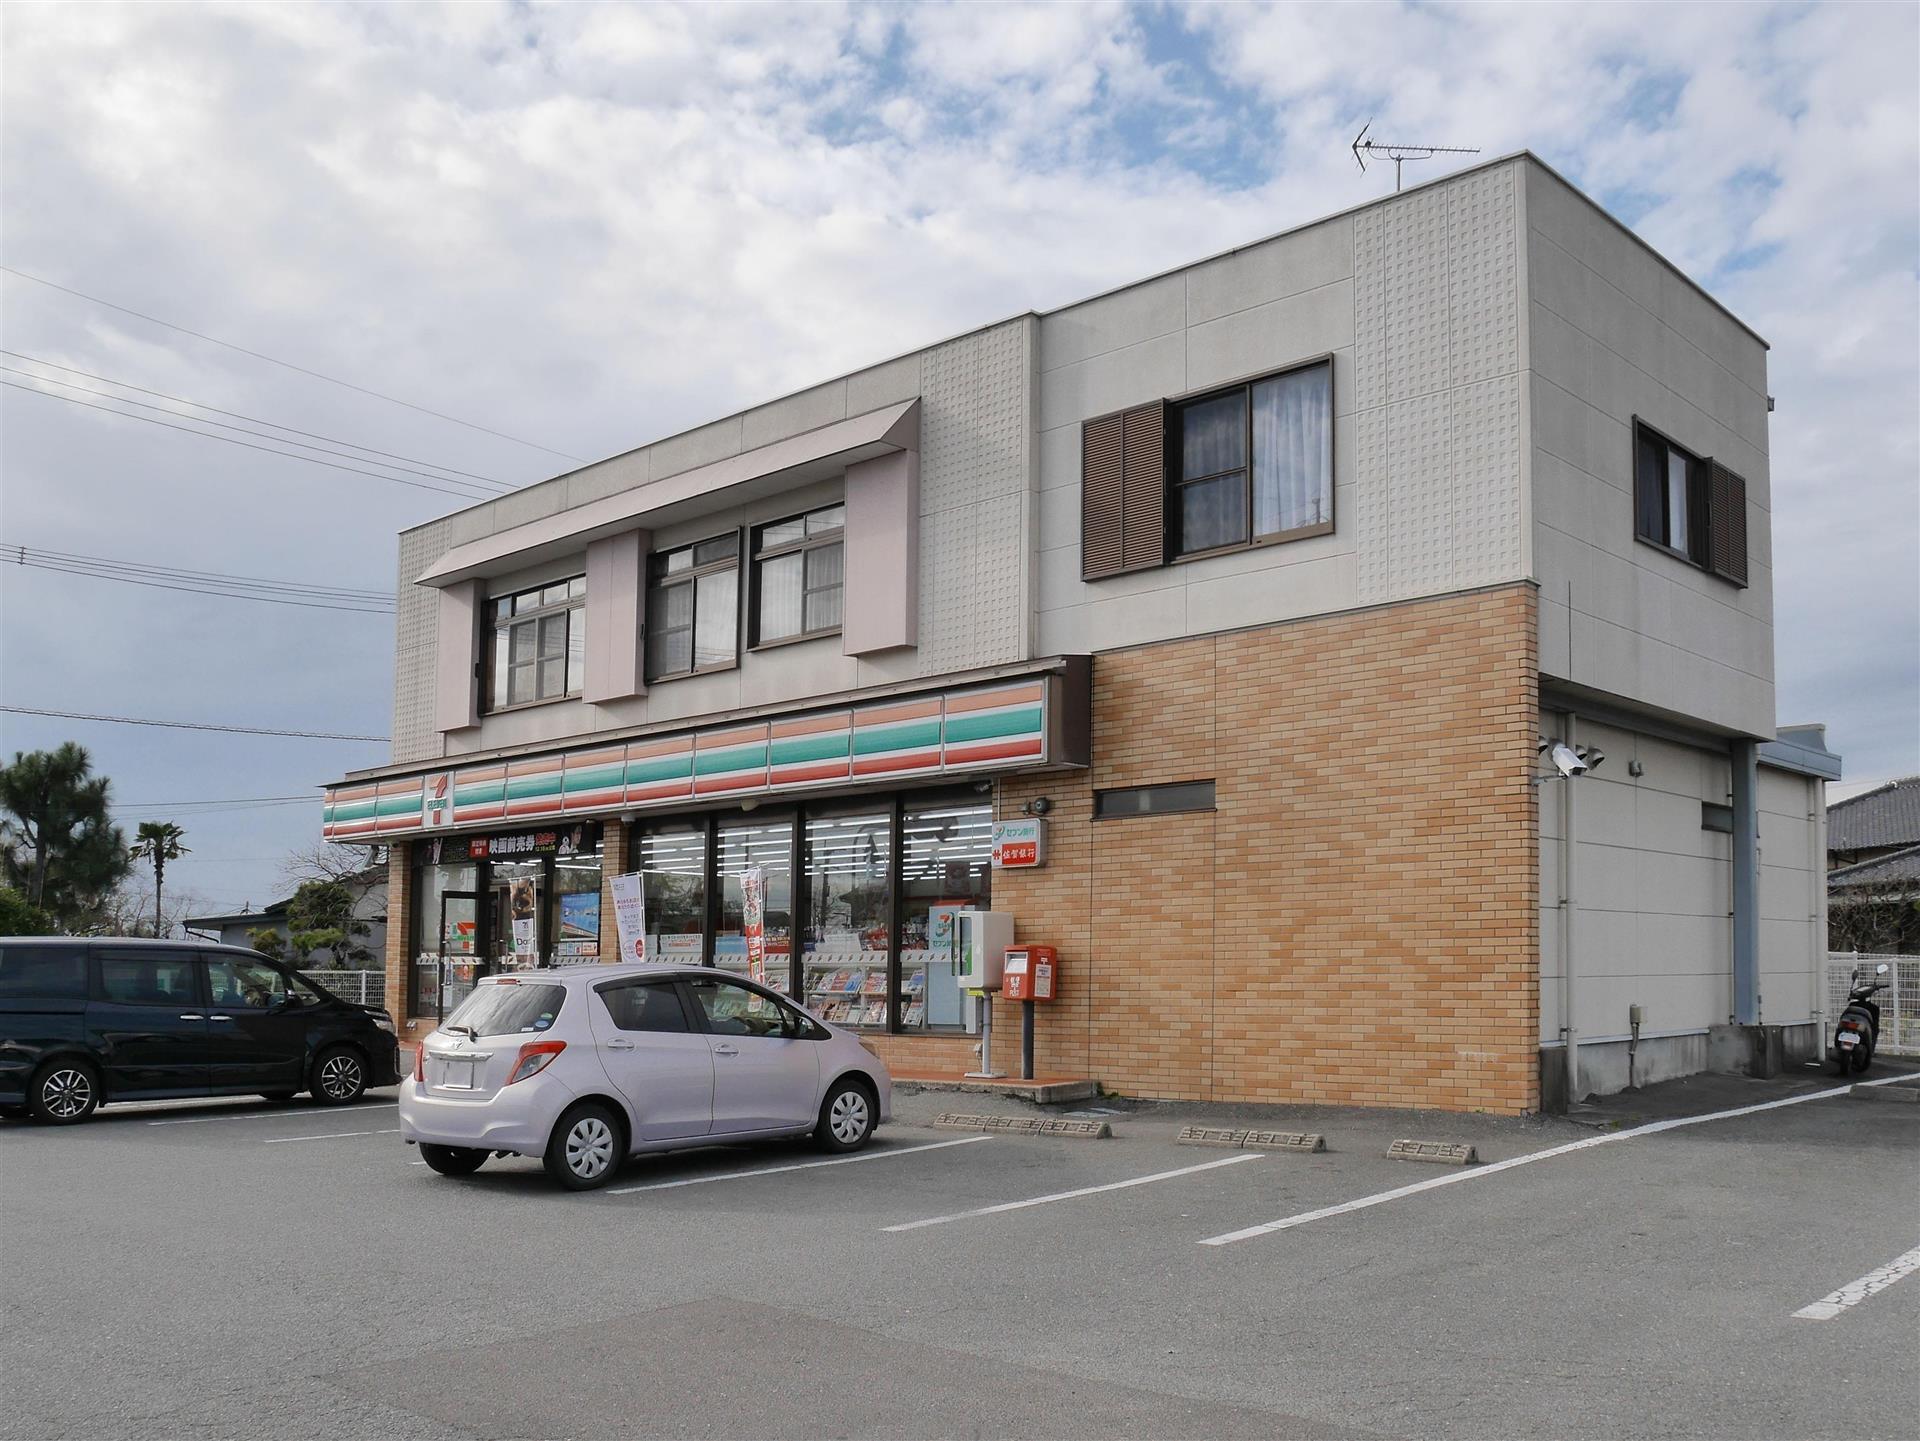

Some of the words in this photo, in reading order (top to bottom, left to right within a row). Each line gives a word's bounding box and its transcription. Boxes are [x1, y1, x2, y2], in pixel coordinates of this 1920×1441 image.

[429, 773, 448, 825] 7
[1006, 827, 1035, 837] セブン銀行
[489, 834, 535, 854] 映画前売券
[1003, 848, 1034, 859] 佐賀銀行
